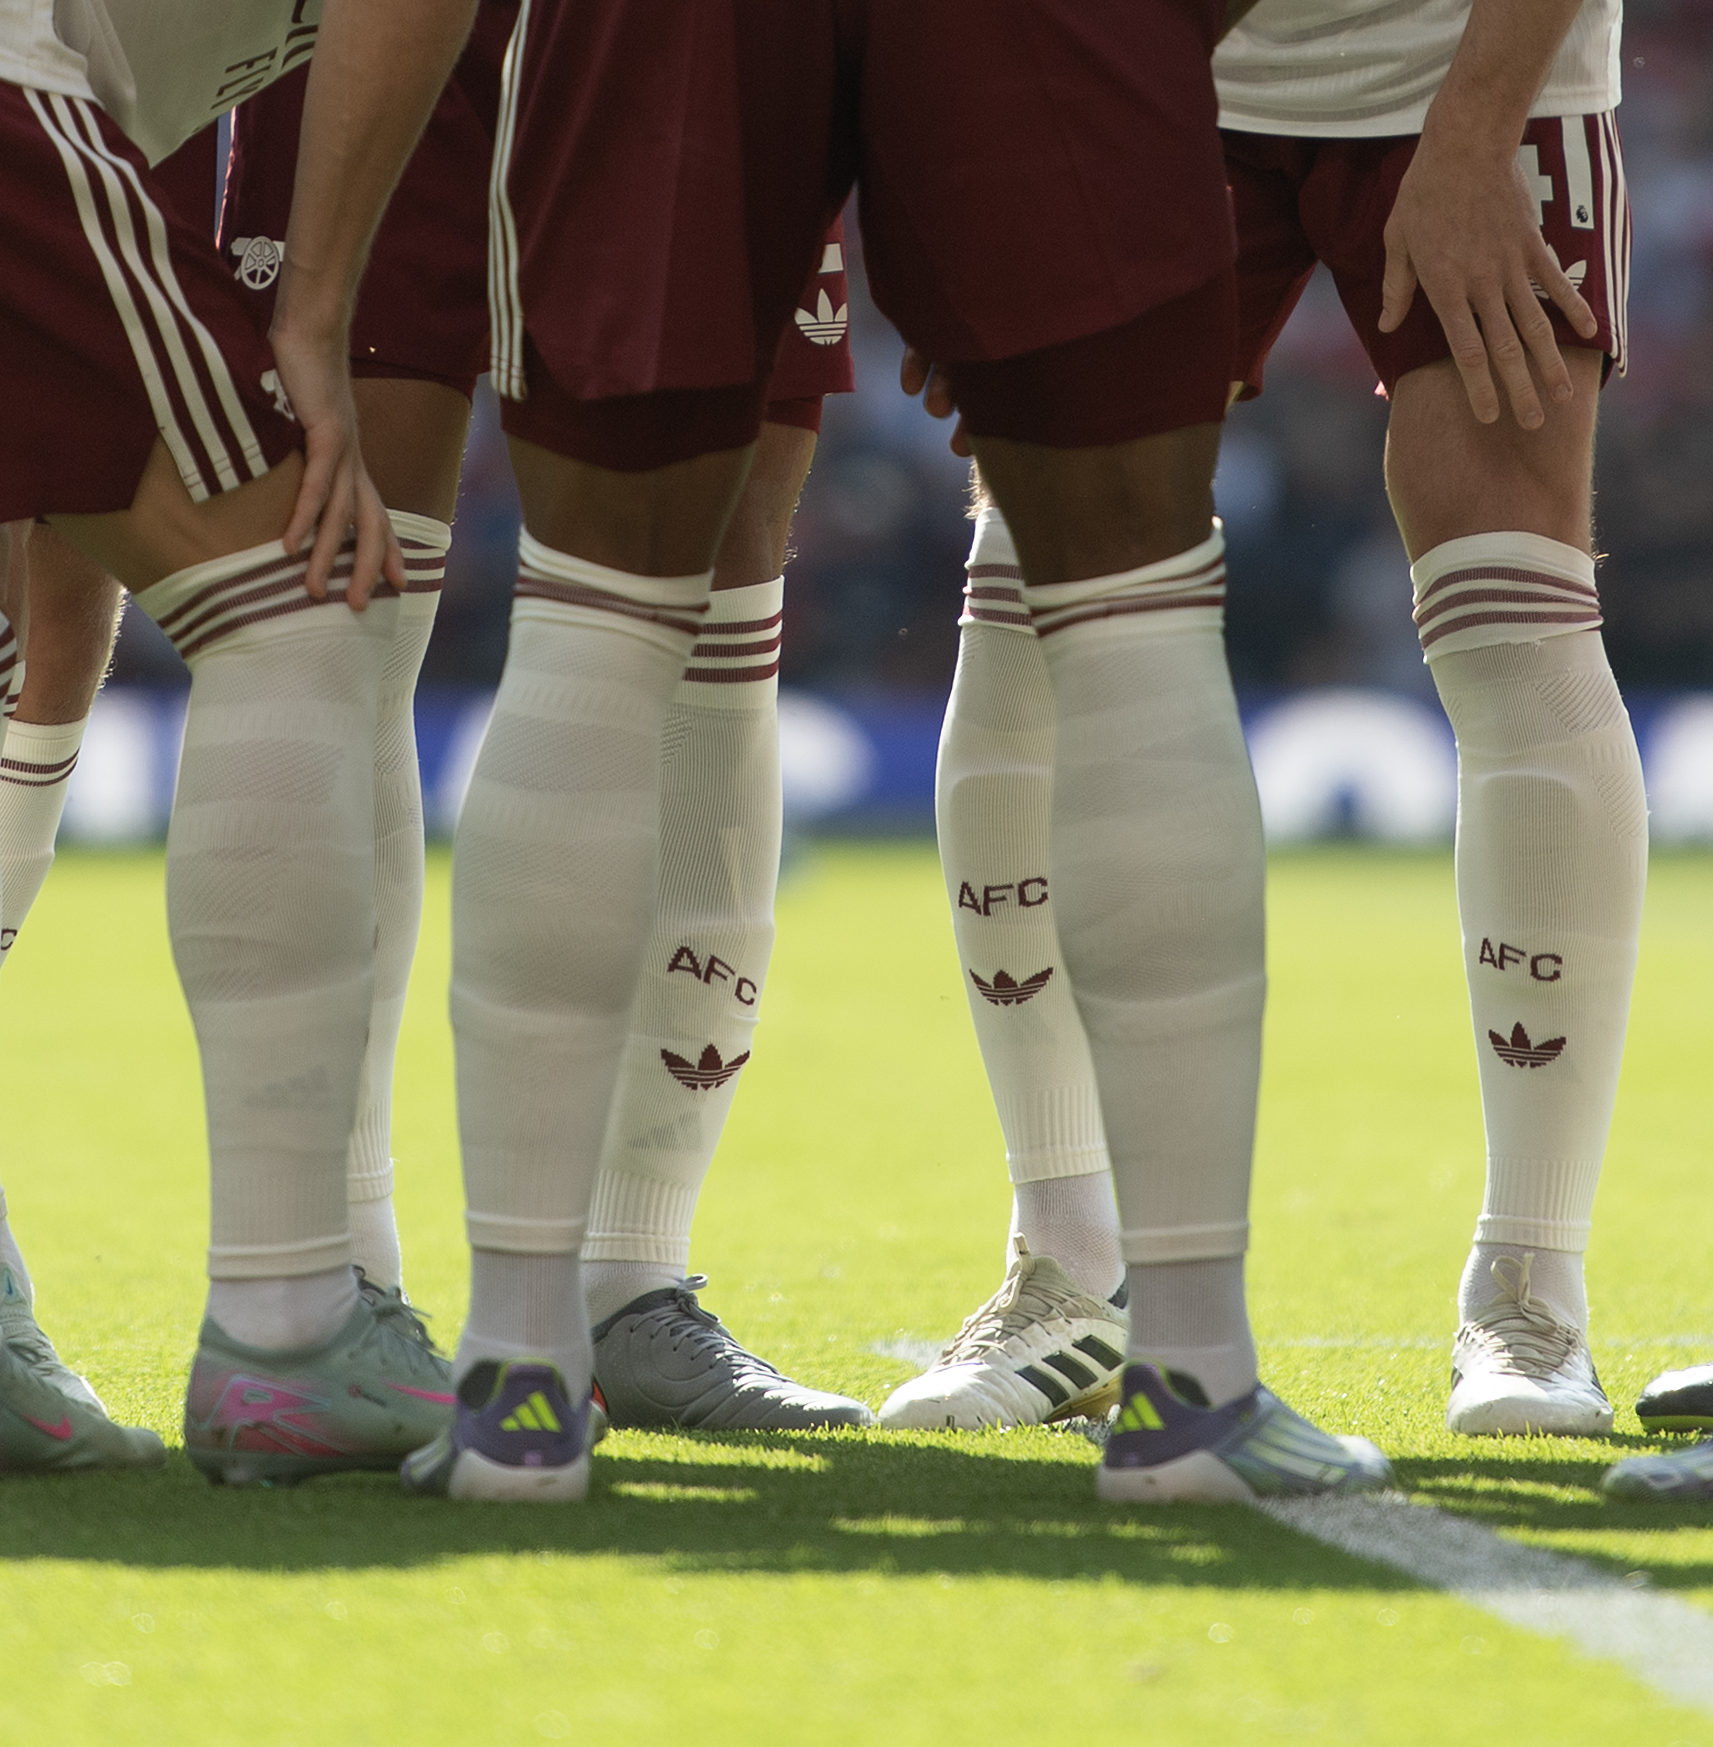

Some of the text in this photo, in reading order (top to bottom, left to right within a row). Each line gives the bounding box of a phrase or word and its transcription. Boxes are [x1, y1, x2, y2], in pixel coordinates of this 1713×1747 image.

[959, 877, 1048, 916] AFC
[667, 946, 757, 1006] AFC
[1479, 938, 1563, 982] AFC
